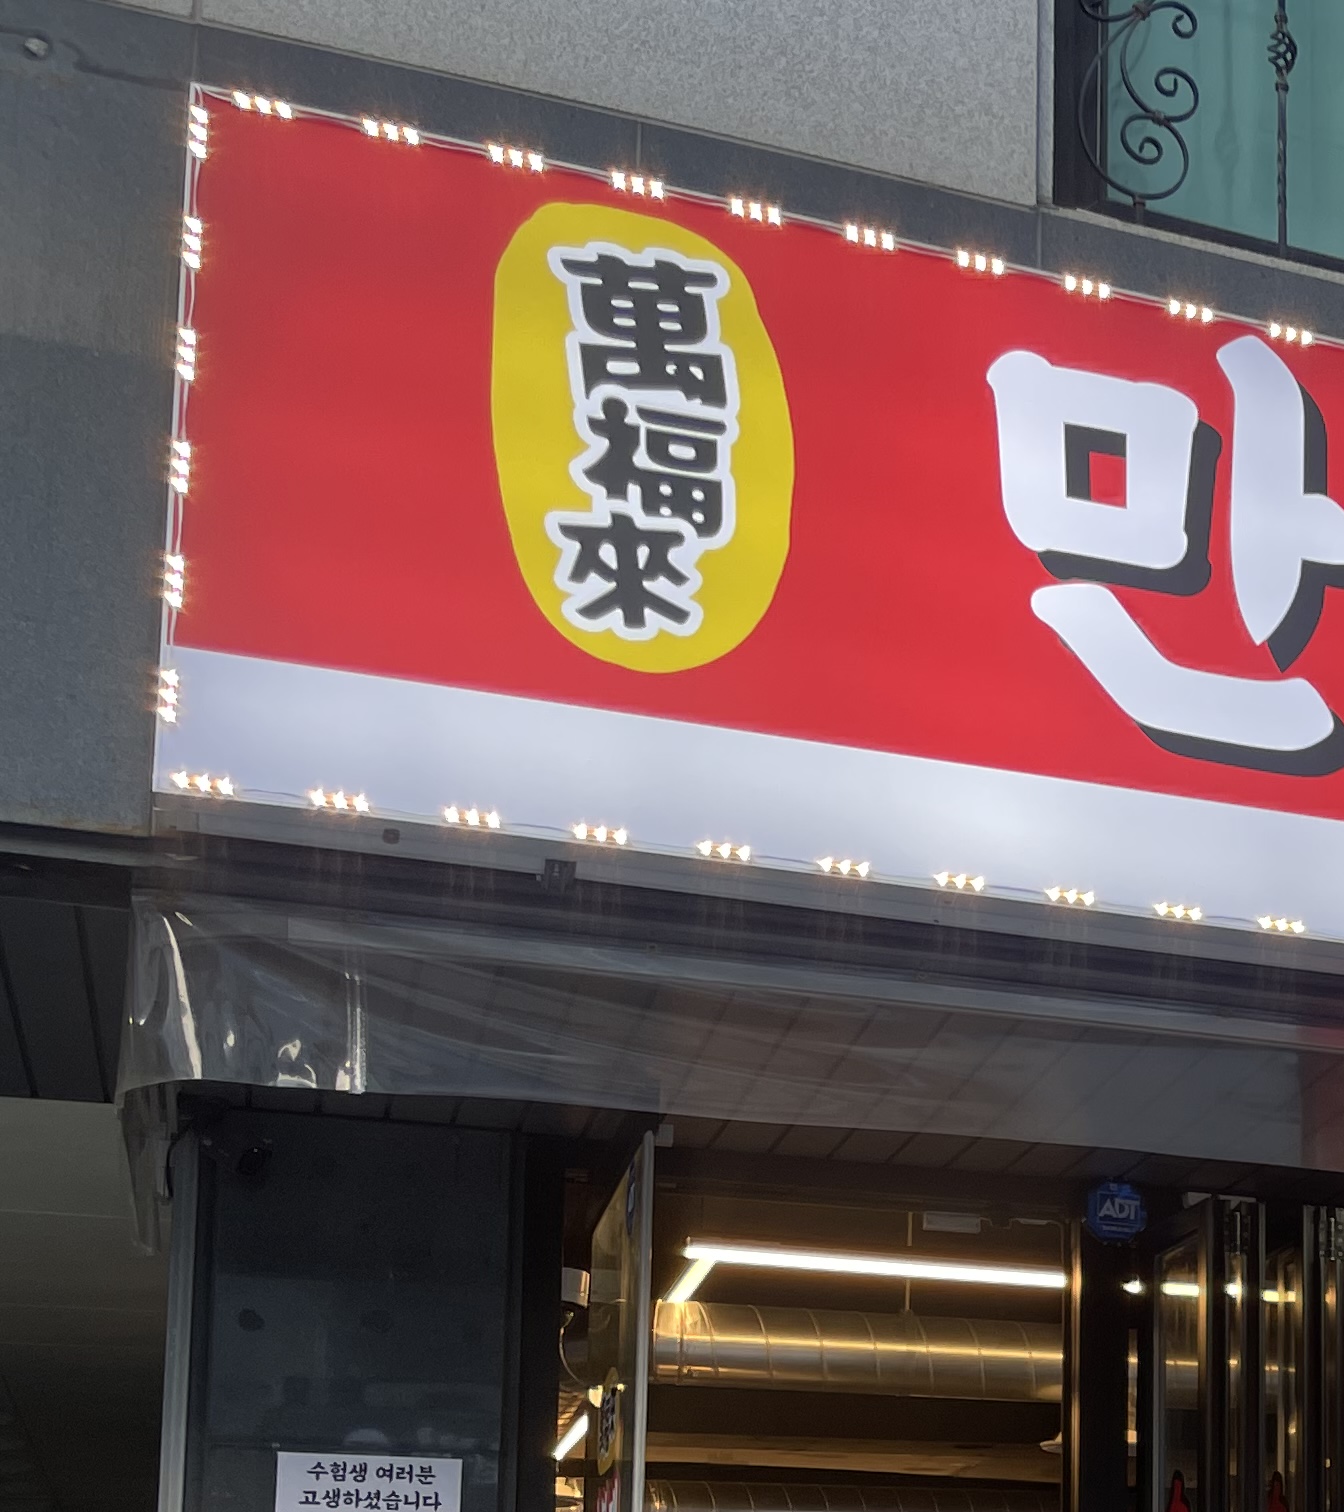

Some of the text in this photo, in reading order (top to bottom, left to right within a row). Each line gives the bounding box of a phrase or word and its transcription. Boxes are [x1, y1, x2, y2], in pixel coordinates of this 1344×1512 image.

[552, 246, 727, 636] 萬福來
[1099, 1198, 1140, 1220] ADT
[307, 1461, 436, 1485] 수험생 여러분
[298, 1488, 442, 1511] 고생하셨습니다
